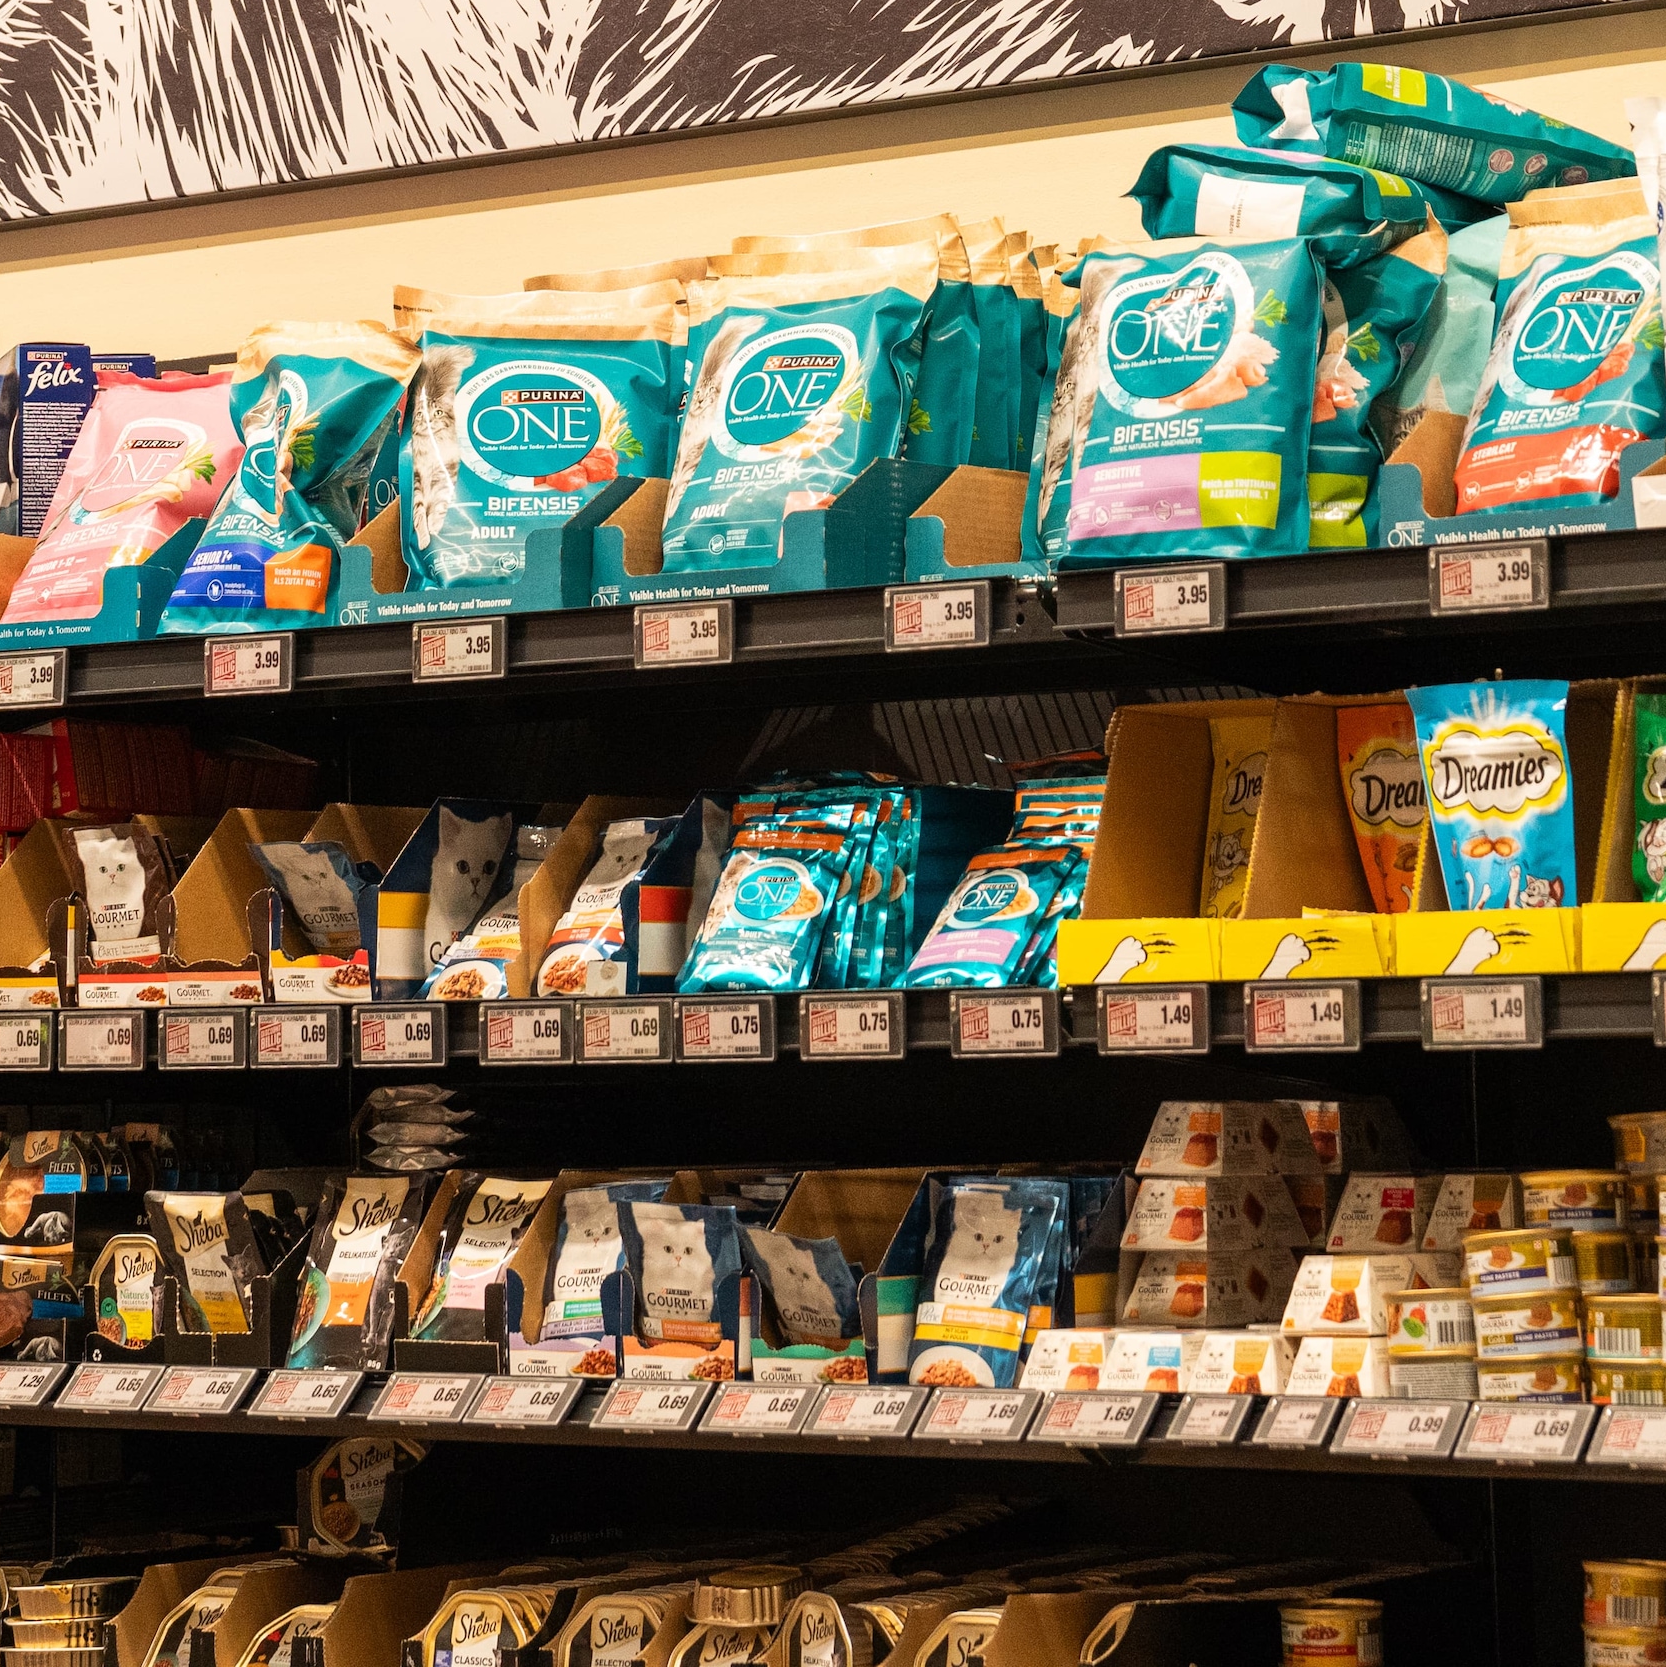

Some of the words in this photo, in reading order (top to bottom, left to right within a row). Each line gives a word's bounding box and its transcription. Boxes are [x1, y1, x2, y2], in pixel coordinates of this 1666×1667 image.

[26, 361, 83, 396] felix
[521, 391, 582, 401] PURINA
[729, 372, 831, 415] ONE
[1498, 403, 1581, 426] BIFENSIS
[473, 406, 591, 444] ONE
[1114, 418, 1199, 445] BIFENSIS
[1094, 466, 1141, 482] SENSITIVE
[1498, 561, 1529, 582] 3.99
[1178, 584, 1208, 605] 3.95
[378, 604, 400, 617] Visible
[402, 602, 425, 615] Health
[427, 602, 438, 613] for
[438, 601, 459, 614] Today
[461, 600, 475, 611] and
[476, 597, 512, 609] Tomorrow
[944, 601, 973, 621] 3.95
[15, 629, 24, 638] for
[25, 627, 46, 639] Today
[48, 627, 54, 635] &
[56, 624, 91, 635] Tomorrow
[465, 636, 490, 654] 3.95
[255, 651, 278, 669] 3.99
[30, 667, 53, 684] 3.99
[1440, 752, 1546, 800] Dreamies
[90, 909, 139, 926] GOURMET
[859, 1012, 887, 1032] 0.75
[1011, 1009, 1041, 1029] 0.75
[1161, 1004, 1191, 1026] 1.49
[1310, 1002, 1341, 1023] 1.49
[301, 1025, 326, 1042] 0.69
[405, 1023, 430, 1040] 0.69
[731, 1014, 758, 1035] 0.75
[339, 1196, 401, 1236] Sheba
[339, 1250, 378, 1259] DELIKATESSE
[191, 1267, 227, 1278] SELECTION
[938, 1276, 999, 1296] GOURMET
[646, 1291, 707, 1311] GOURMET
[205, 1381, 233, 1395] 0.65
[311, 1382, 339, 1399] 0.65
[658, 1392, 690, 1411] 0.69
[768, 1396, 798, 1414] 0.69
[987, 1401, 1018, 1420] 1.69
[1408, 1415, 1442, 1433] 0.99
[1534, 1418, 1569, 1437] 0.69
